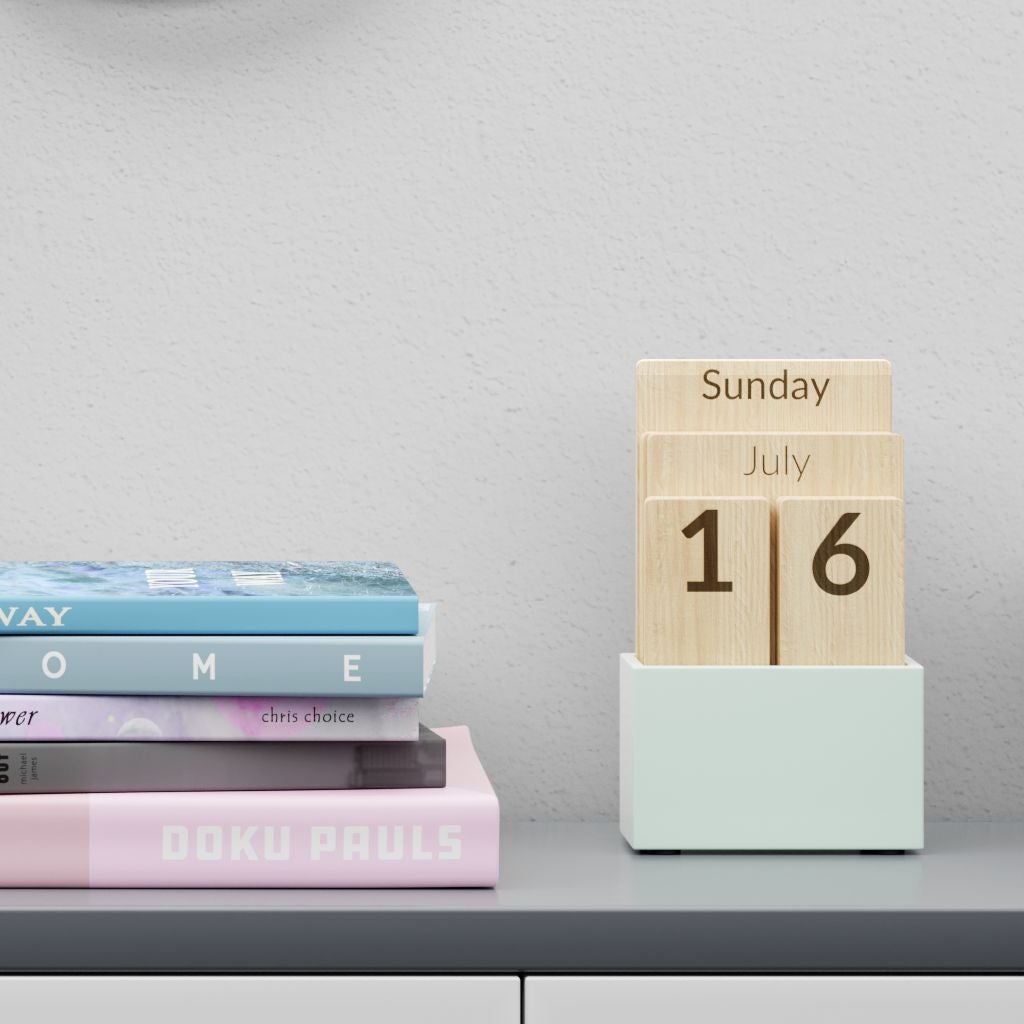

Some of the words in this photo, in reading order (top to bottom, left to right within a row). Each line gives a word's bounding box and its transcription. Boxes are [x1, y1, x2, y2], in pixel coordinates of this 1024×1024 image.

[702, 369, 831, 406] Sunday
[743, 445, 811, 482] July
[261, 707, 298, 723] chris
[304, 707, 355, 723] choice
[19, 752, 28, 785] michael
[30, 757, 39, 780] james
[162, 825, 291, 861] DOKU
[311, 825, 462, 860] PAULS
